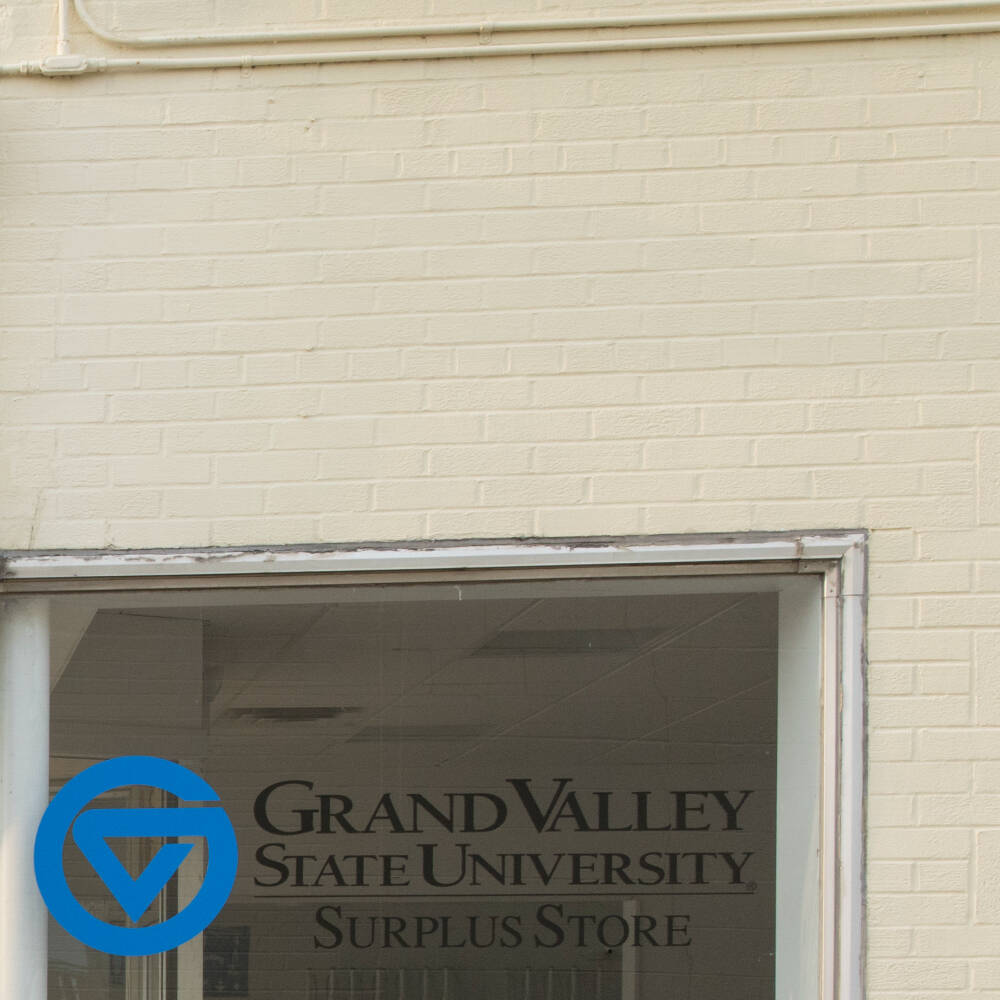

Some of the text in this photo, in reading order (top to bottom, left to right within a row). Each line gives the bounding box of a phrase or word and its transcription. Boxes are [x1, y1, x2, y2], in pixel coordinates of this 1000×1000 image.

[253, 842, 755, 888] STATE UNIVERSITY
[313, 903, 693, 950] SURPLUS STORE
